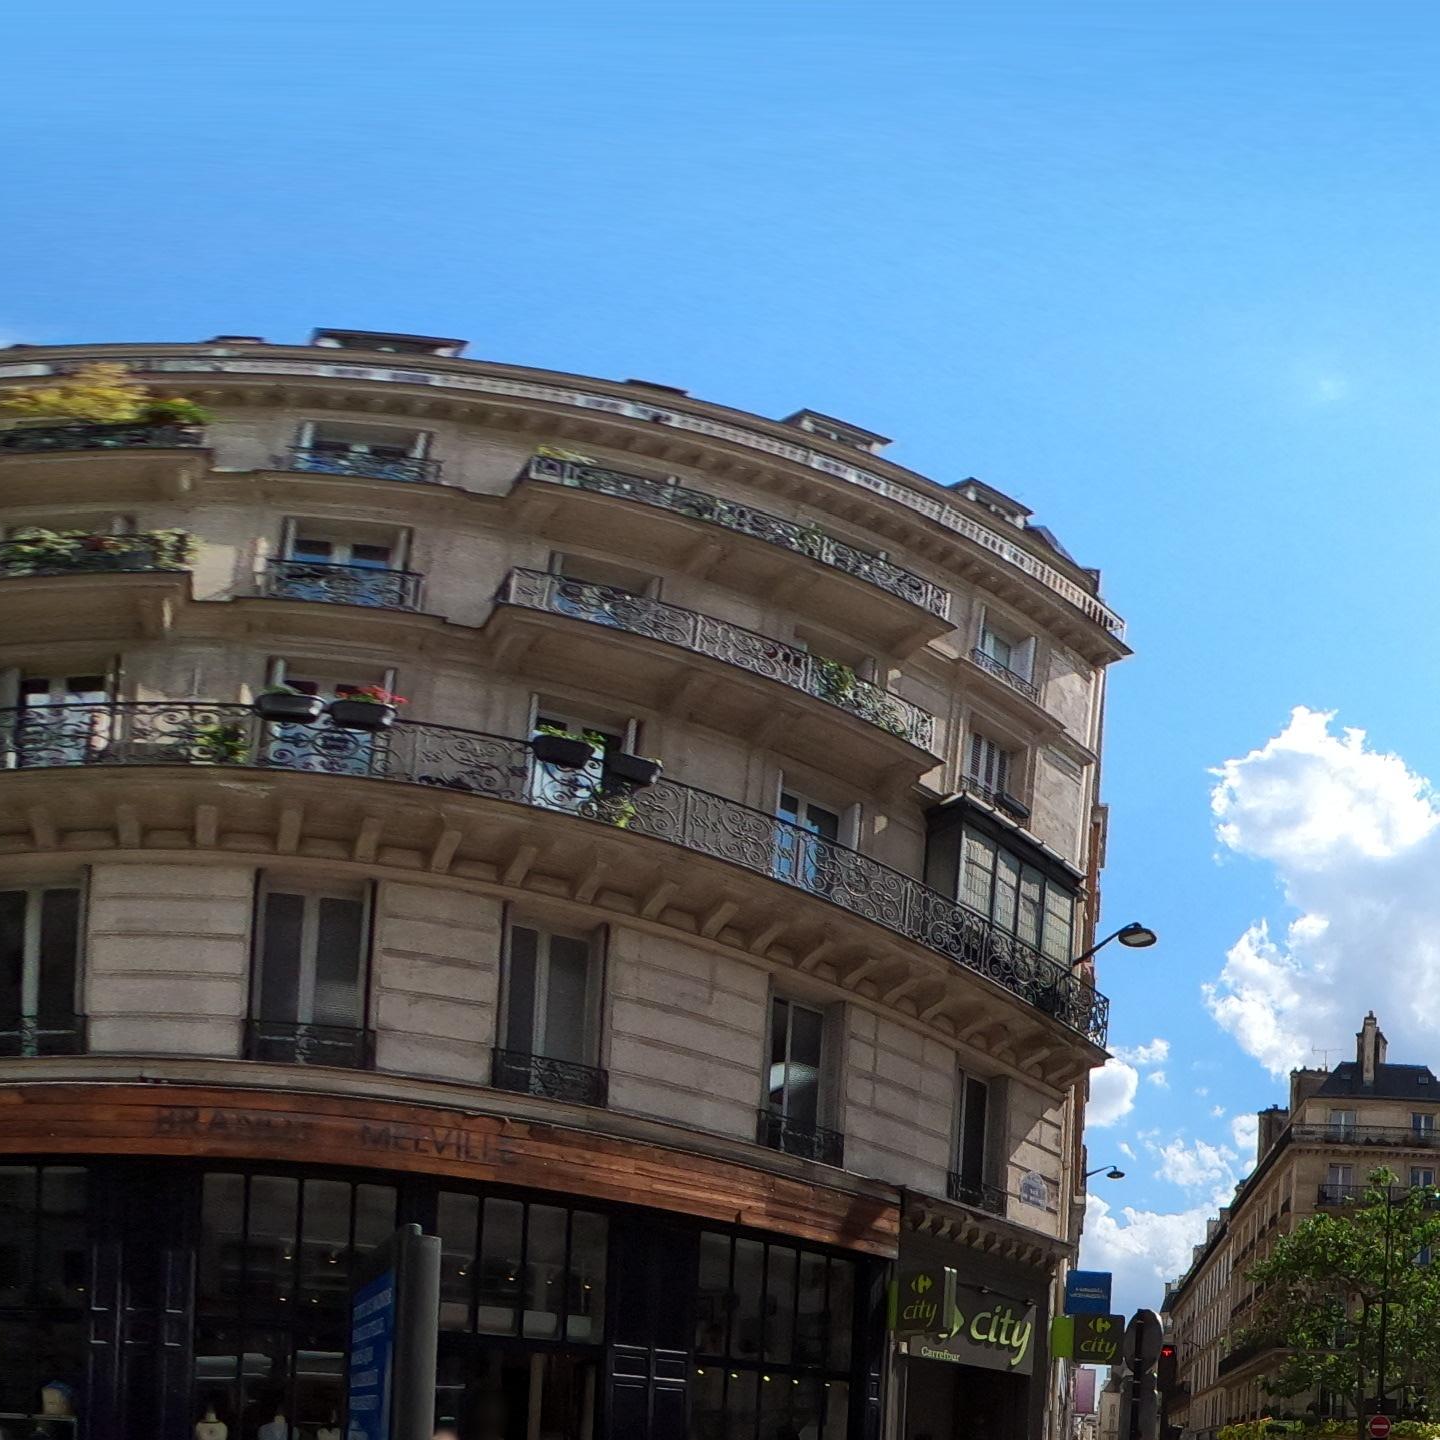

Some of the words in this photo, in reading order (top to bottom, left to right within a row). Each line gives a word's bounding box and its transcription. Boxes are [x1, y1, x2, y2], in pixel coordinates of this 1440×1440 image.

[903, 1300, 937, 1328] city
[969, 1305, 1032, 1367] city
[1080, 1336, 1117, 1360] city
[921, 1346, 961, 1362] Carrefour
